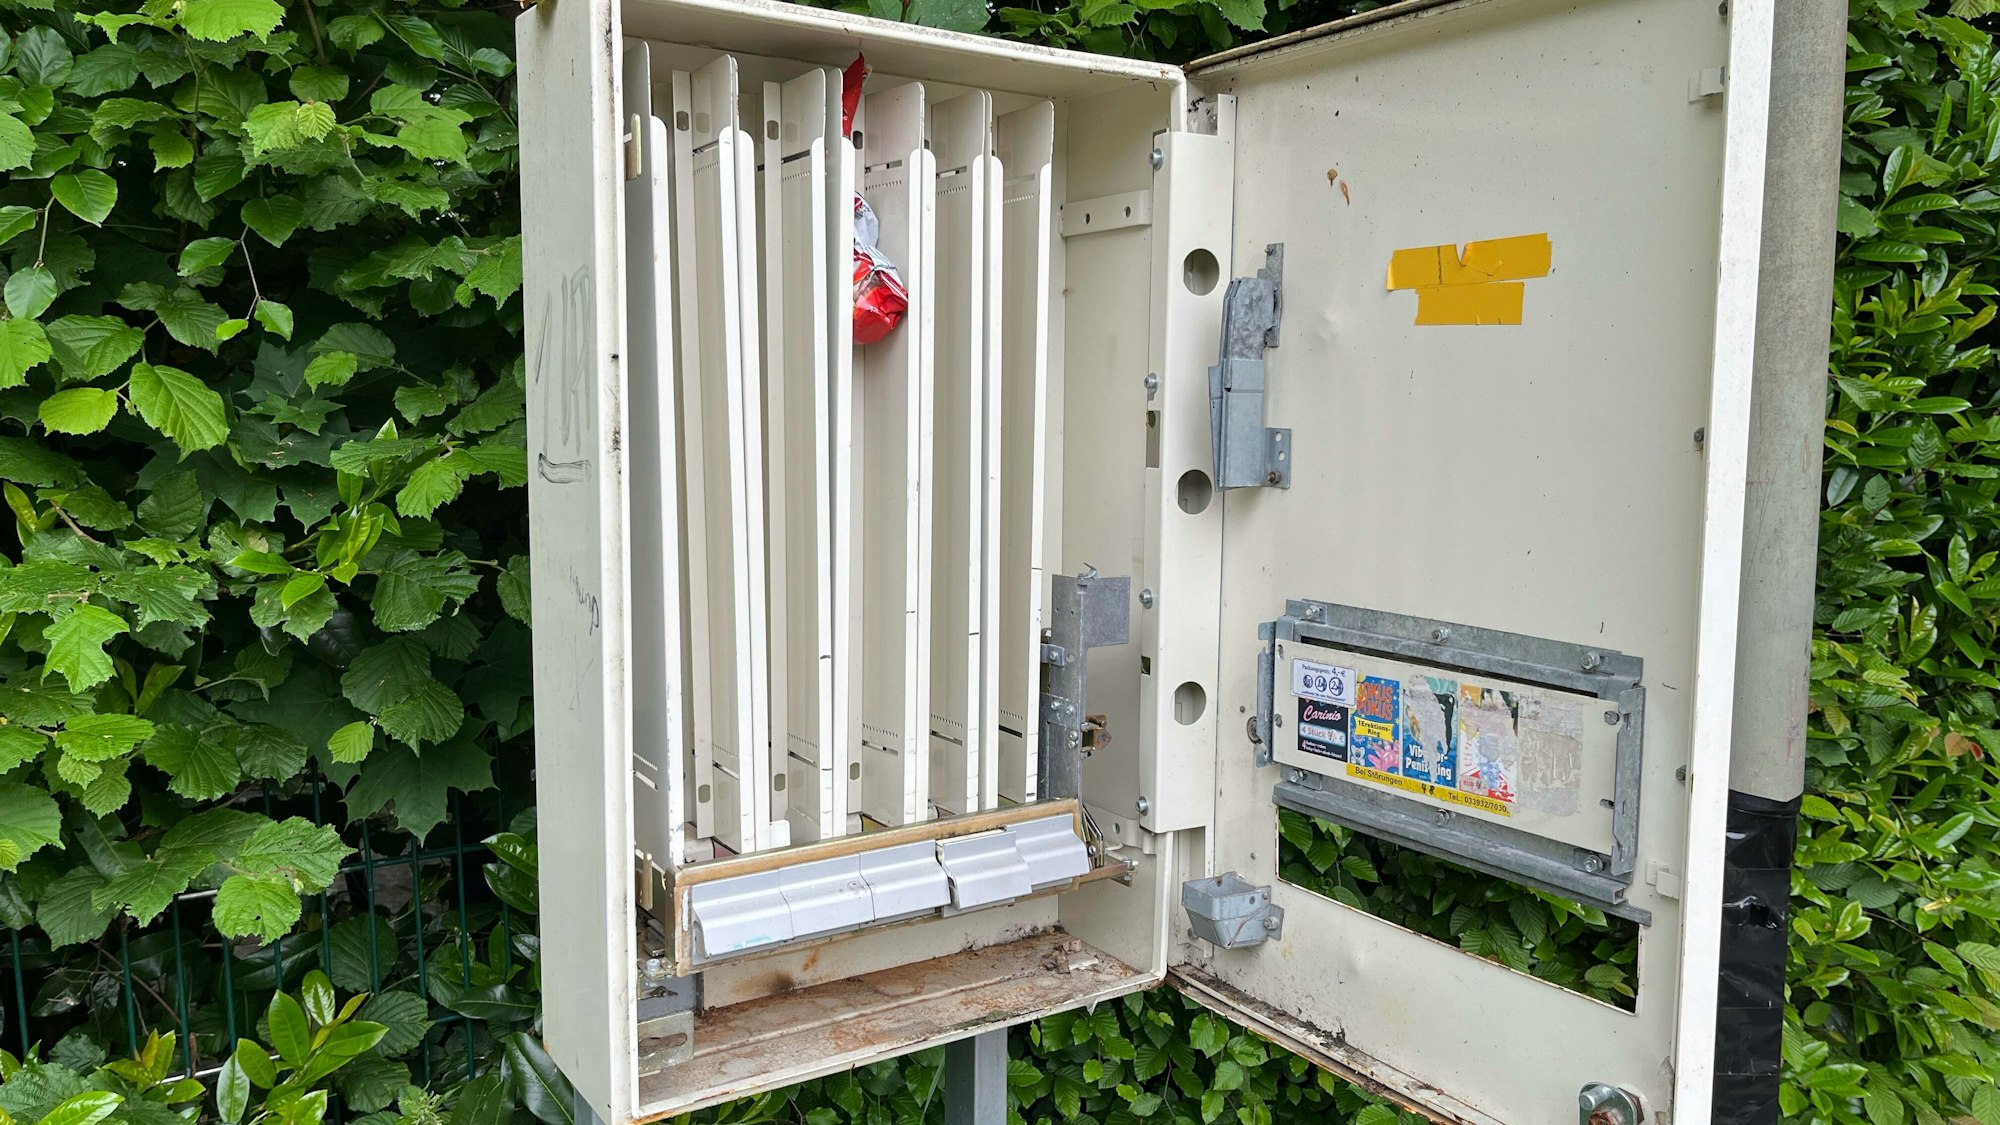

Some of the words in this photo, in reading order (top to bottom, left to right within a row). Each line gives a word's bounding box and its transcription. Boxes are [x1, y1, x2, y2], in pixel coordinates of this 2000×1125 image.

[1303, 705, 1342, 721] Carinio
[1367, 729, 1380, 738] Ring
[1355, 766, 1366, 776] Bei
[1367, 770, 1403, 785] Störungen
